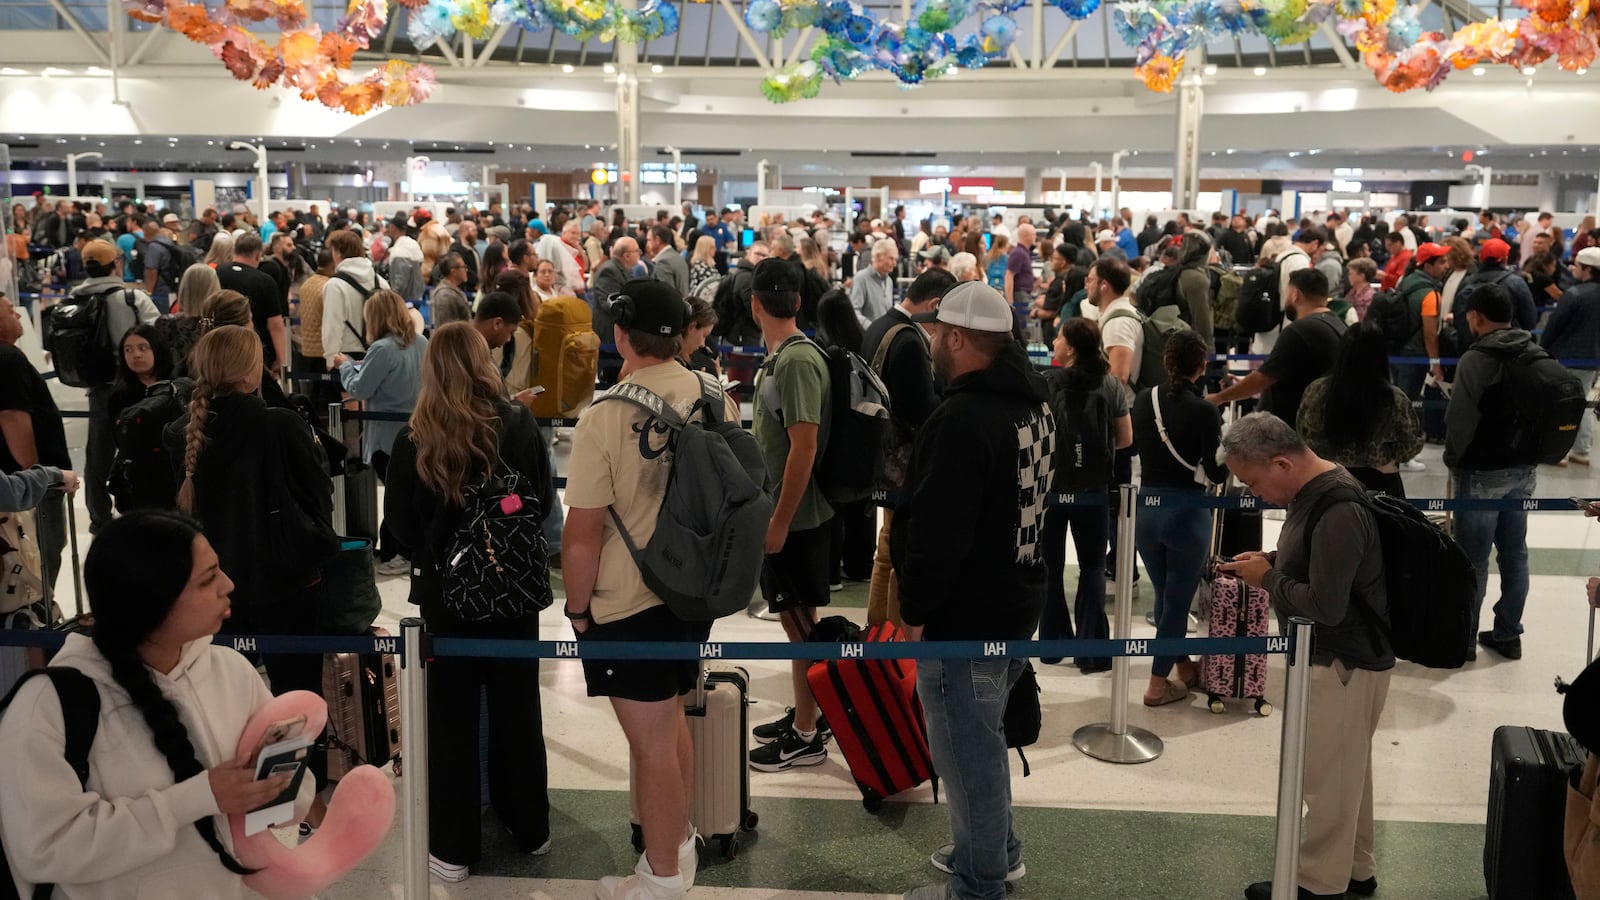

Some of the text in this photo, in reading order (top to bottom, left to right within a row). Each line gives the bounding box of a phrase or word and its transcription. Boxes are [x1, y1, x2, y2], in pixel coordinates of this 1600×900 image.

[551, 418, 563, 426] IAH
[1074, 442, 1082, 468] Fracht
[871, 490, 887, 501] IAH
[1059, 493, 1075, 503] IAH
[1145, 495, 1160, 506] IAH
[1240, 498, 1255, 508] IAH
[1428, 500, 1444, 510] IAH
[1523, 500, 1538, 510] IAH
[233, 638, 257, 651] IAH
[374, 639, 396, 652] IAH
[555, 642, 578, 656] IAH
[699, 643, 722, 657] IAH
[841, 643, 864, 657] IAH
[984, 642, 1006, 656] IAH
[1125, 640, 1148, 654] IAH
[1266, 637, 1289, 651] IAH
